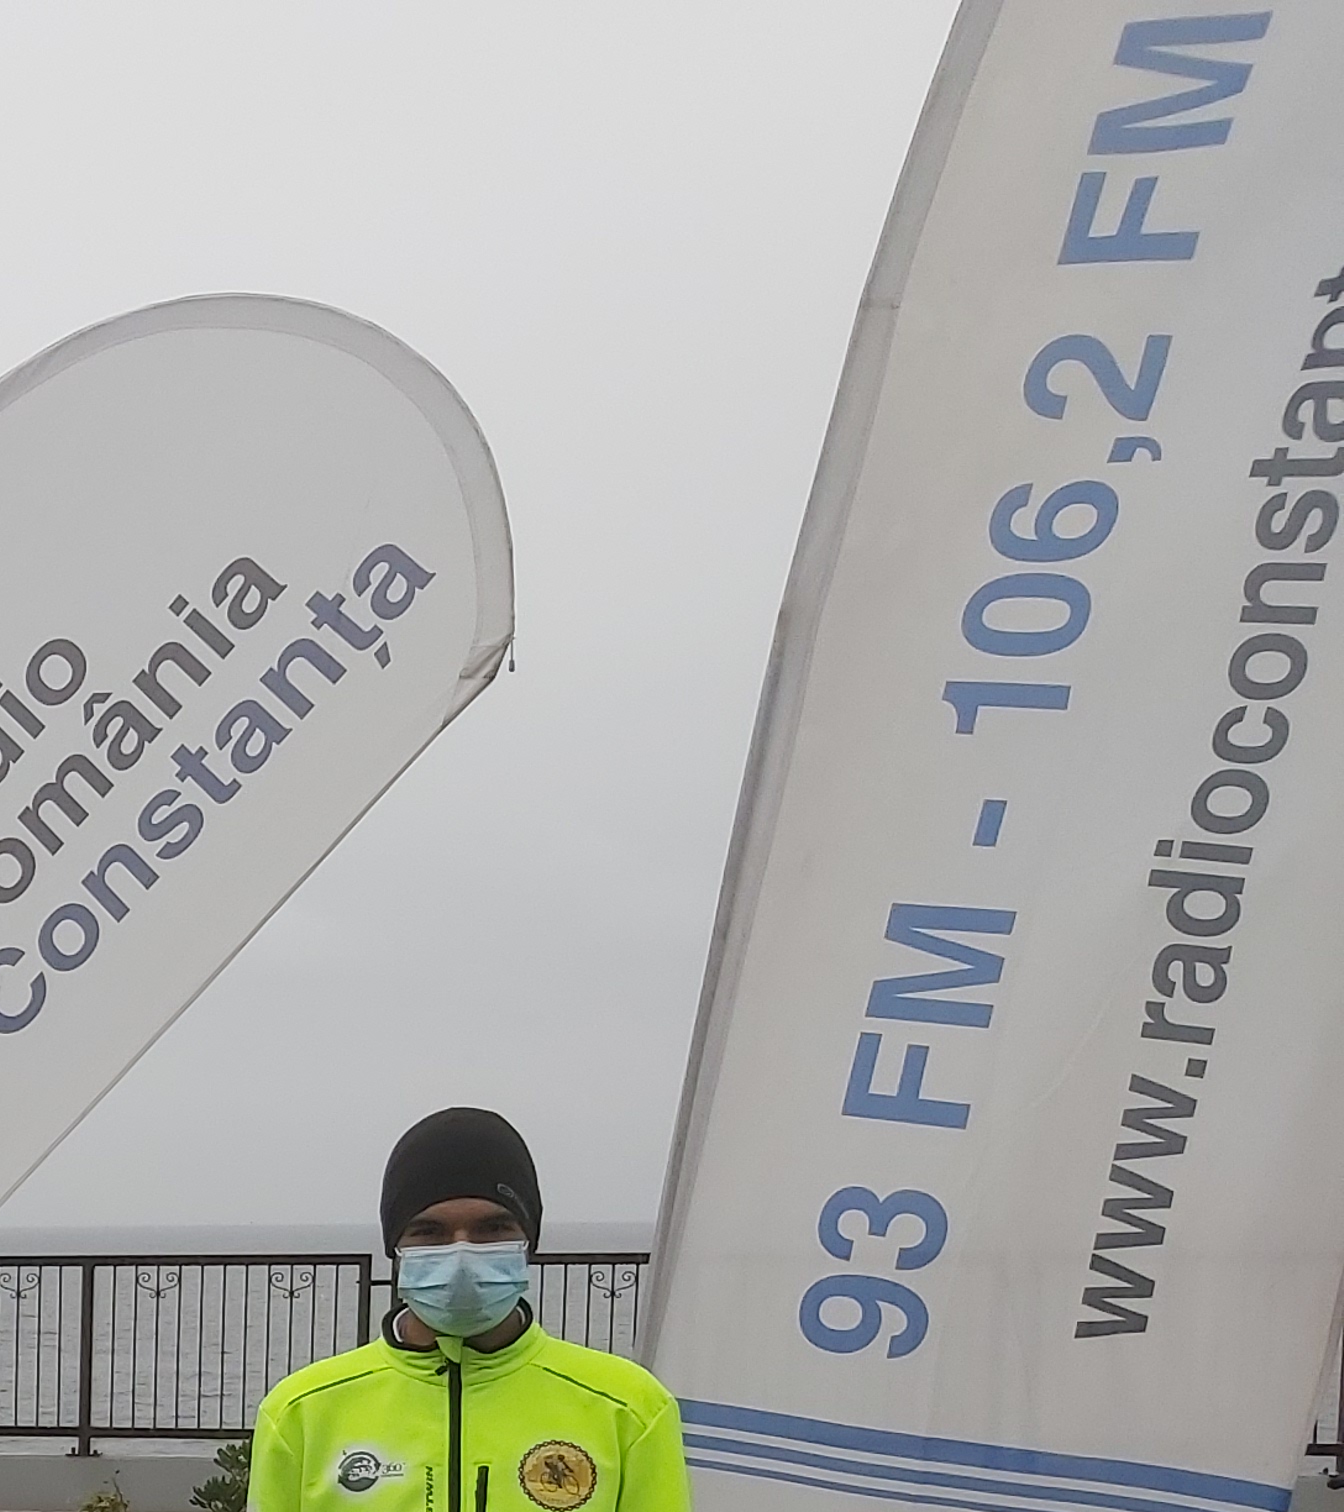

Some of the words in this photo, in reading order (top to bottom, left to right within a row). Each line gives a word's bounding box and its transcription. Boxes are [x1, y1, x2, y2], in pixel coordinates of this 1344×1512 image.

[1057, 11, 1274, 266] FM
[942, 333, 1173, 735] 106,2
[972, 799, 1008, 847] -
[841, 902, 1018, 1129] FM
[799, 1185, 950, 1359] 93
